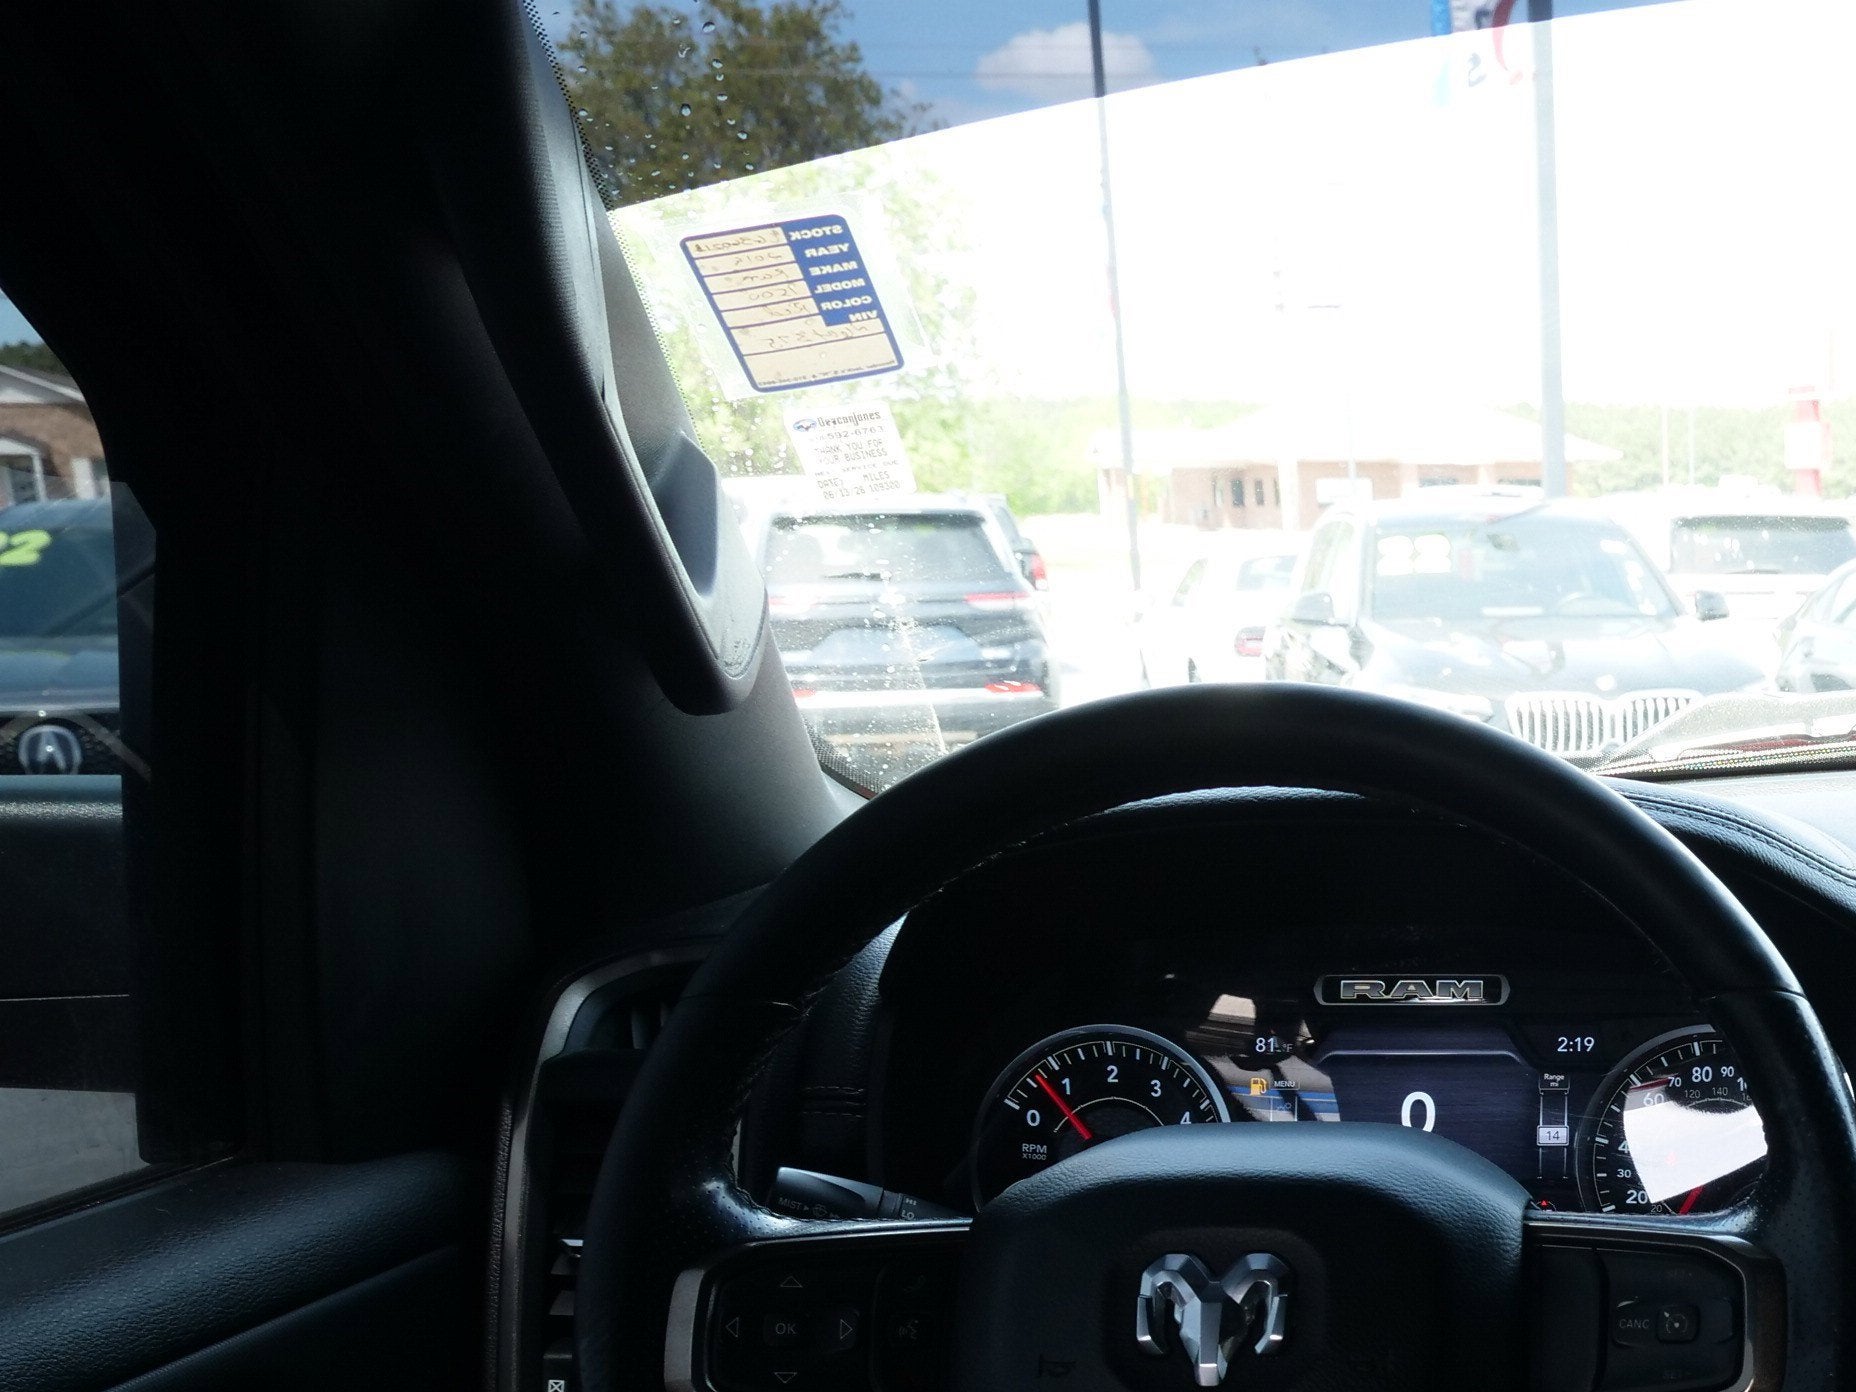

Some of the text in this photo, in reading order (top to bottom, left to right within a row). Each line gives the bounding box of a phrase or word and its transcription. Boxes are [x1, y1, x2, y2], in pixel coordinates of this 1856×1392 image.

[846, 442, 863, 452] YOU
[845, 448, 888, 462] BUSINESS
[862, 471, 890, 482] MILES
[0, 529, 53, 567] 2
[1339, 979, 1485, 1000] RAM
[1254, 1037, 1275, 1052] 81
[1556, 1036, 1596, 1053] 2:19
[1106, 1065, 1119, 1083] 2
[1543, 1073, 1566, 1083] Range
[1691, 1066, 1713, 1082] 80
[1720, 1066, 1735, 1078] 90
[1061, 1078, 1072, 1095] 1
[1150, 1079, 1162, 1097] 3
[1273, 1080, 1296, 1088] MENU
[1668, 1076, 1682, 1088] 70
[1684, 1089, 1701, 1099] 120
[1711, 1086, 1729, 1096] 140
[1026, 1109, 1041, 1127] 0
[1180, 1111, 1192, 1124] 4
[1400, 1091, 1436, 1132] 0
[1545, 1130, 1560, 1141] 14
[1021, 1143, 1048, 1154] RPM
[1616, 1169, 1632, 1178] 30
[1625, 1189, 1649, 1204] 20
[778, 1197, 803, 1211] MIST
[1650, 1204, 1663, 1214] 20
[900, 1209, 915, 1220] LO
[774, 1322, 799, 1336] OK
[1618, 1318, 1651, 1330] CANC
